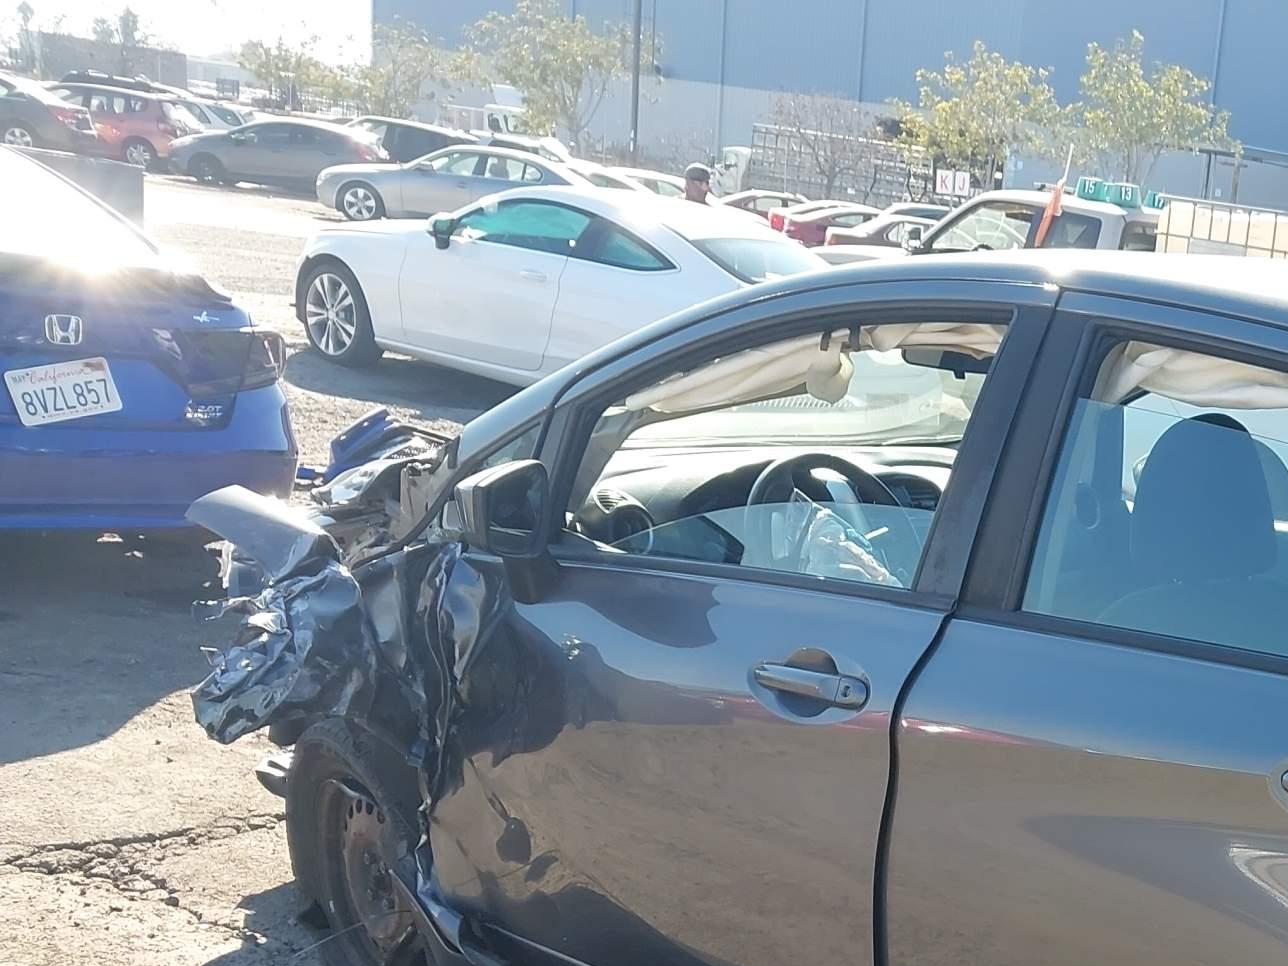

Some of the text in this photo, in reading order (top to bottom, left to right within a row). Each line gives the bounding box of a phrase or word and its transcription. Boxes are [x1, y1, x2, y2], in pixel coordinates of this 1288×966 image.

[1084, 180, 1096, 194] 15
[1121, 186, 1133, 201] 13
[21, 378, 111, 417] 8VZL857
